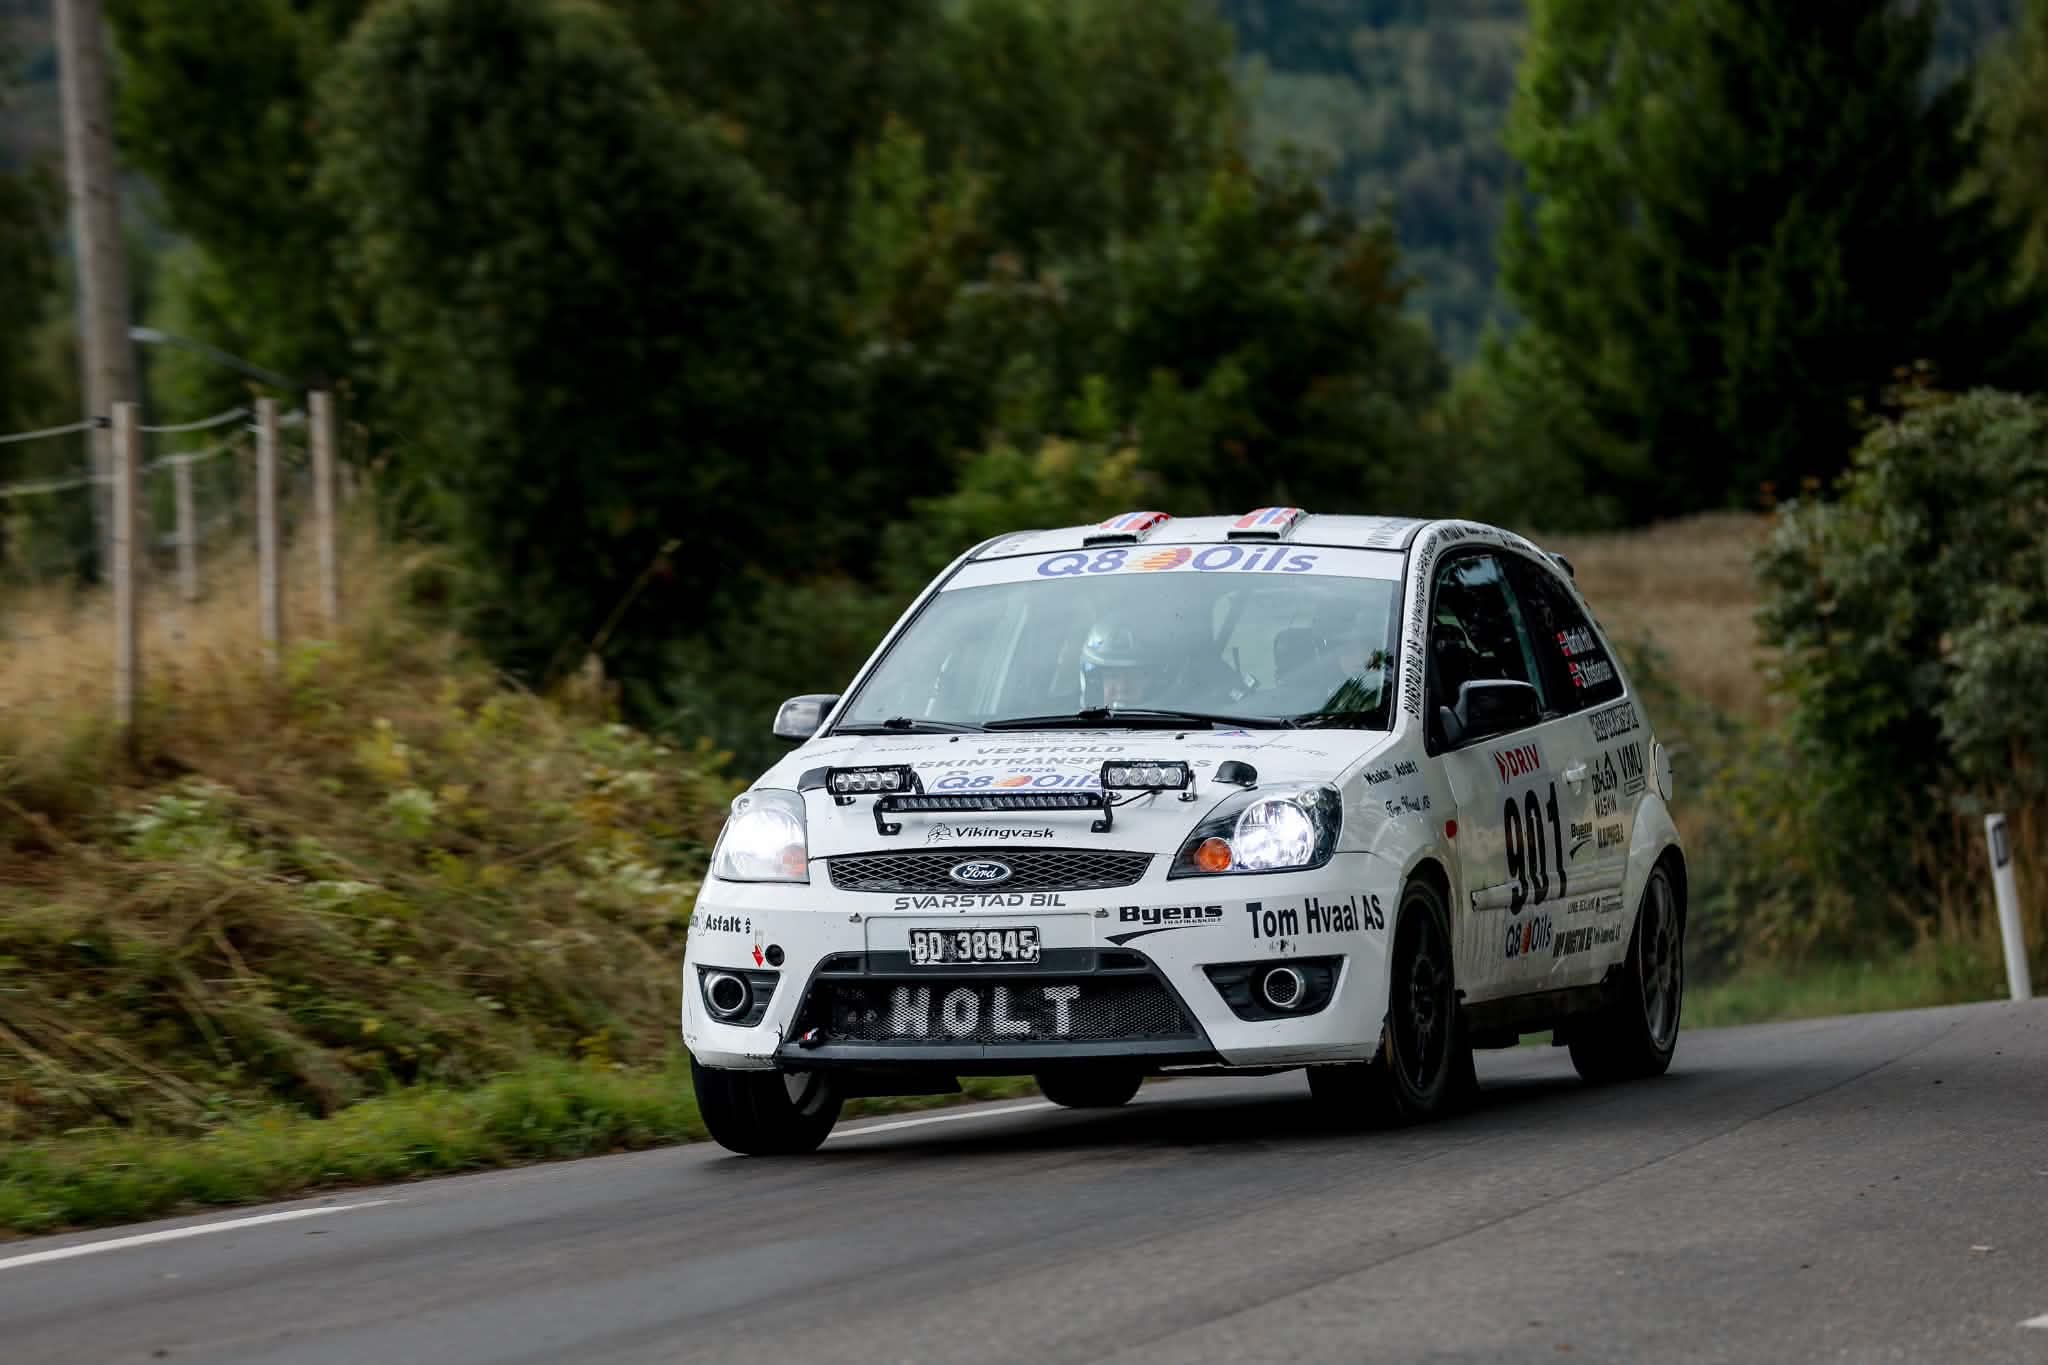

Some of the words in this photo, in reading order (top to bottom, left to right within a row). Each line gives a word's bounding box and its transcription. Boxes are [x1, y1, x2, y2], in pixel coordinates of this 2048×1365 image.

[1037, 549, 1128, 576] Q8
[1192, 547, 1319, 572] Oils
[977, 745, 1125, 755] VESTFOLD
[1509, 743, 1540, 777] DRIV
[1617, 743, 1643, 779] VMU
[912, 757, 1170, 769] SKINTRANSP
[937, 775, 994, 790] Q8
[1032, 774, 1102, 788] Oils
[955, 827, 1055, 840] Vikingvask
[1503, 781, 1567, 915] 901
[962, 863, 998, 880] Ford
[893, 893, 1024, 911] SVARSTAD
[1030, 893, 1067, 907] BIL
[705, 913, 741, 933] Asfalt
[1119, 905, 1223, 925] Byens
[1246, 901, 1299, 939] Tom
[1304, 896, 1358, 935] Hvaal
[1363, 894, 1385, 931] AS
[957, 930, 1035, 960] 38945
[1505, 924, 1521, 959] Q8
[1531, 914, 1552, 952] Oils
[891, 984, 1081, 1038] HOLT
